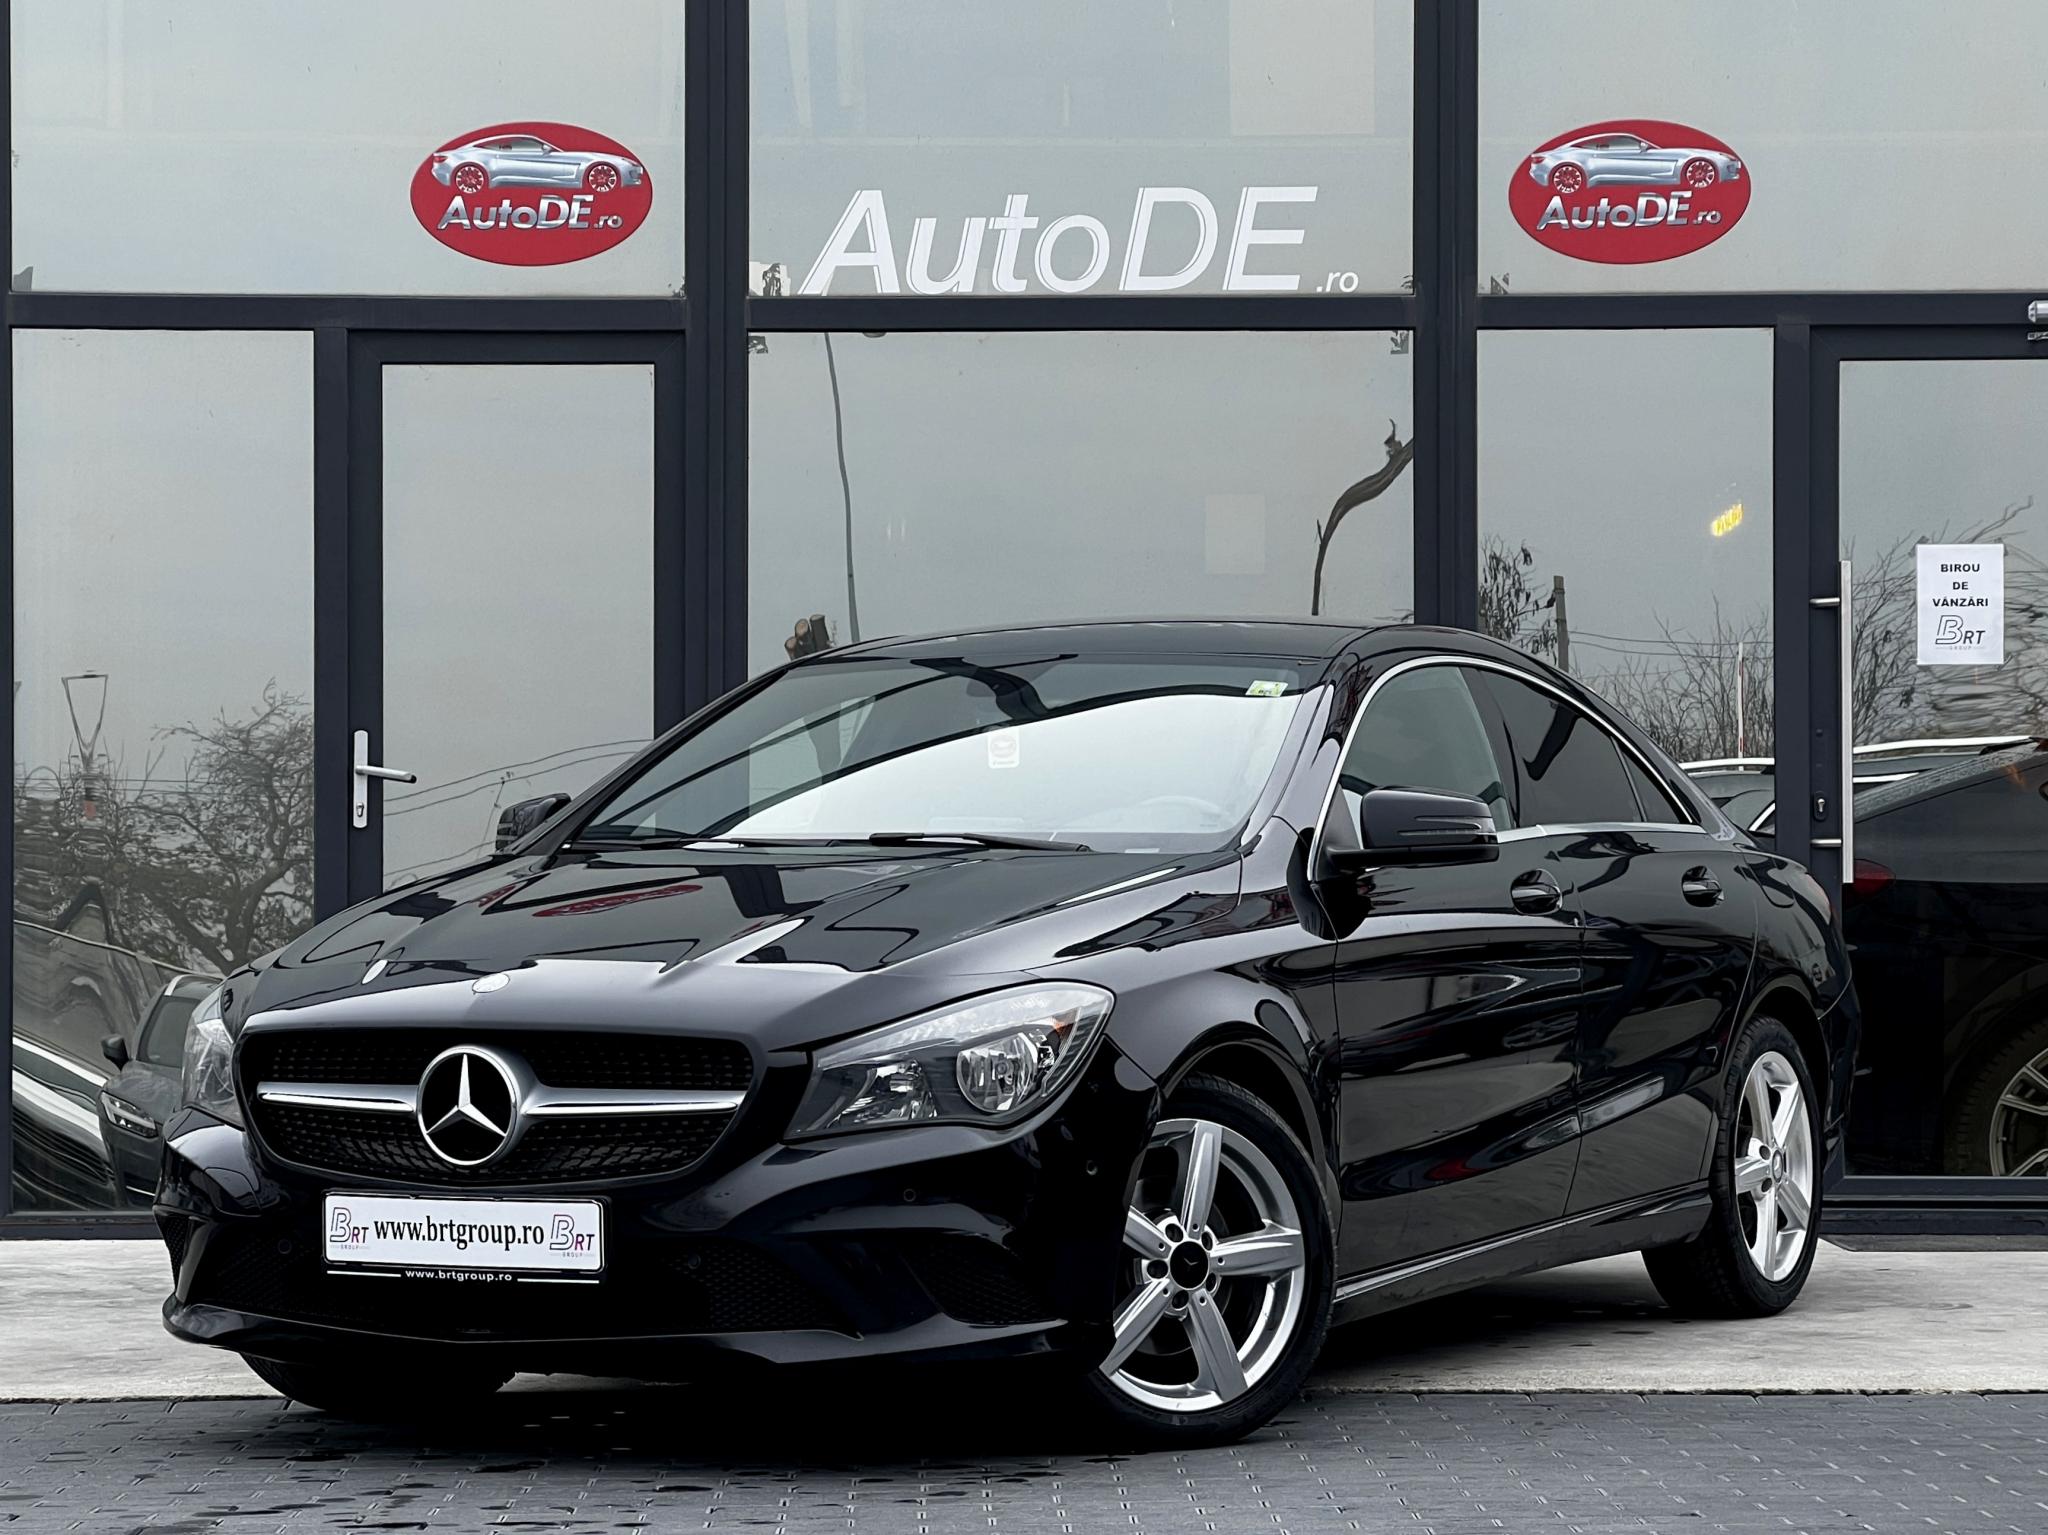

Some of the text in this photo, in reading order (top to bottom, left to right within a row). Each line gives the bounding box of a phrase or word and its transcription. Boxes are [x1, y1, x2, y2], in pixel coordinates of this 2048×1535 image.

[1940, 563, 1981, 573] BIROU
[1952, 581, 1969, 590] DE
[373, 1215, 545, 1252] www.brtgroup.ro
[405, 1269, 513, 1283] www.brtgroup.ro
